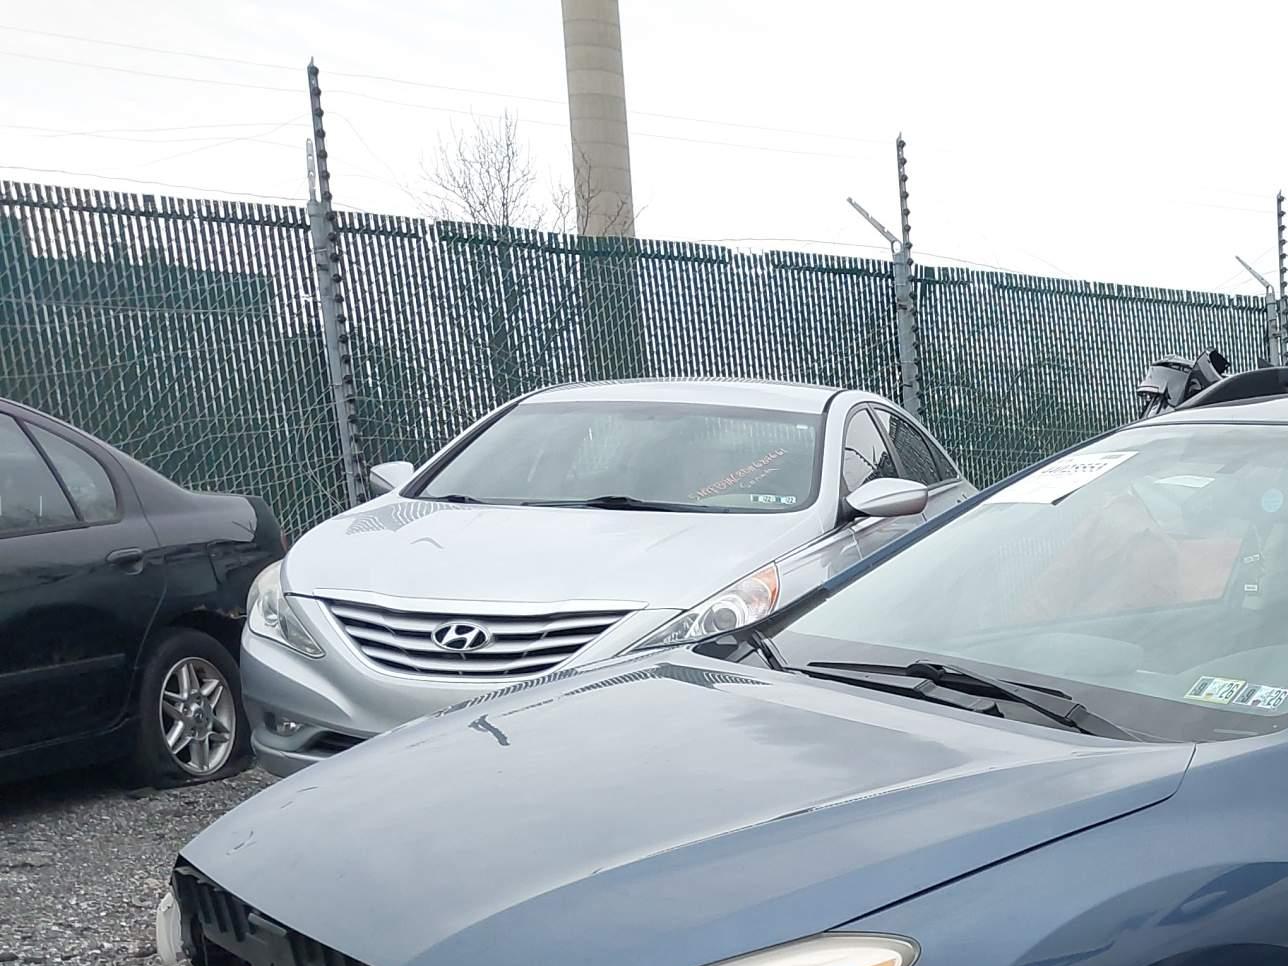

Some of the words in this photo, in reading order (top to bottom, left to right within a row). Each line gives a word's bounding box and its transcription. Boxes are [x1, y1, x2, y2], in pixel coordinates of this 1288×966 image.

[1217, 682, 1240, 700] 26
[1241, 688, 1256, 704] 9
[1266, 690, 1288, 707] 26
